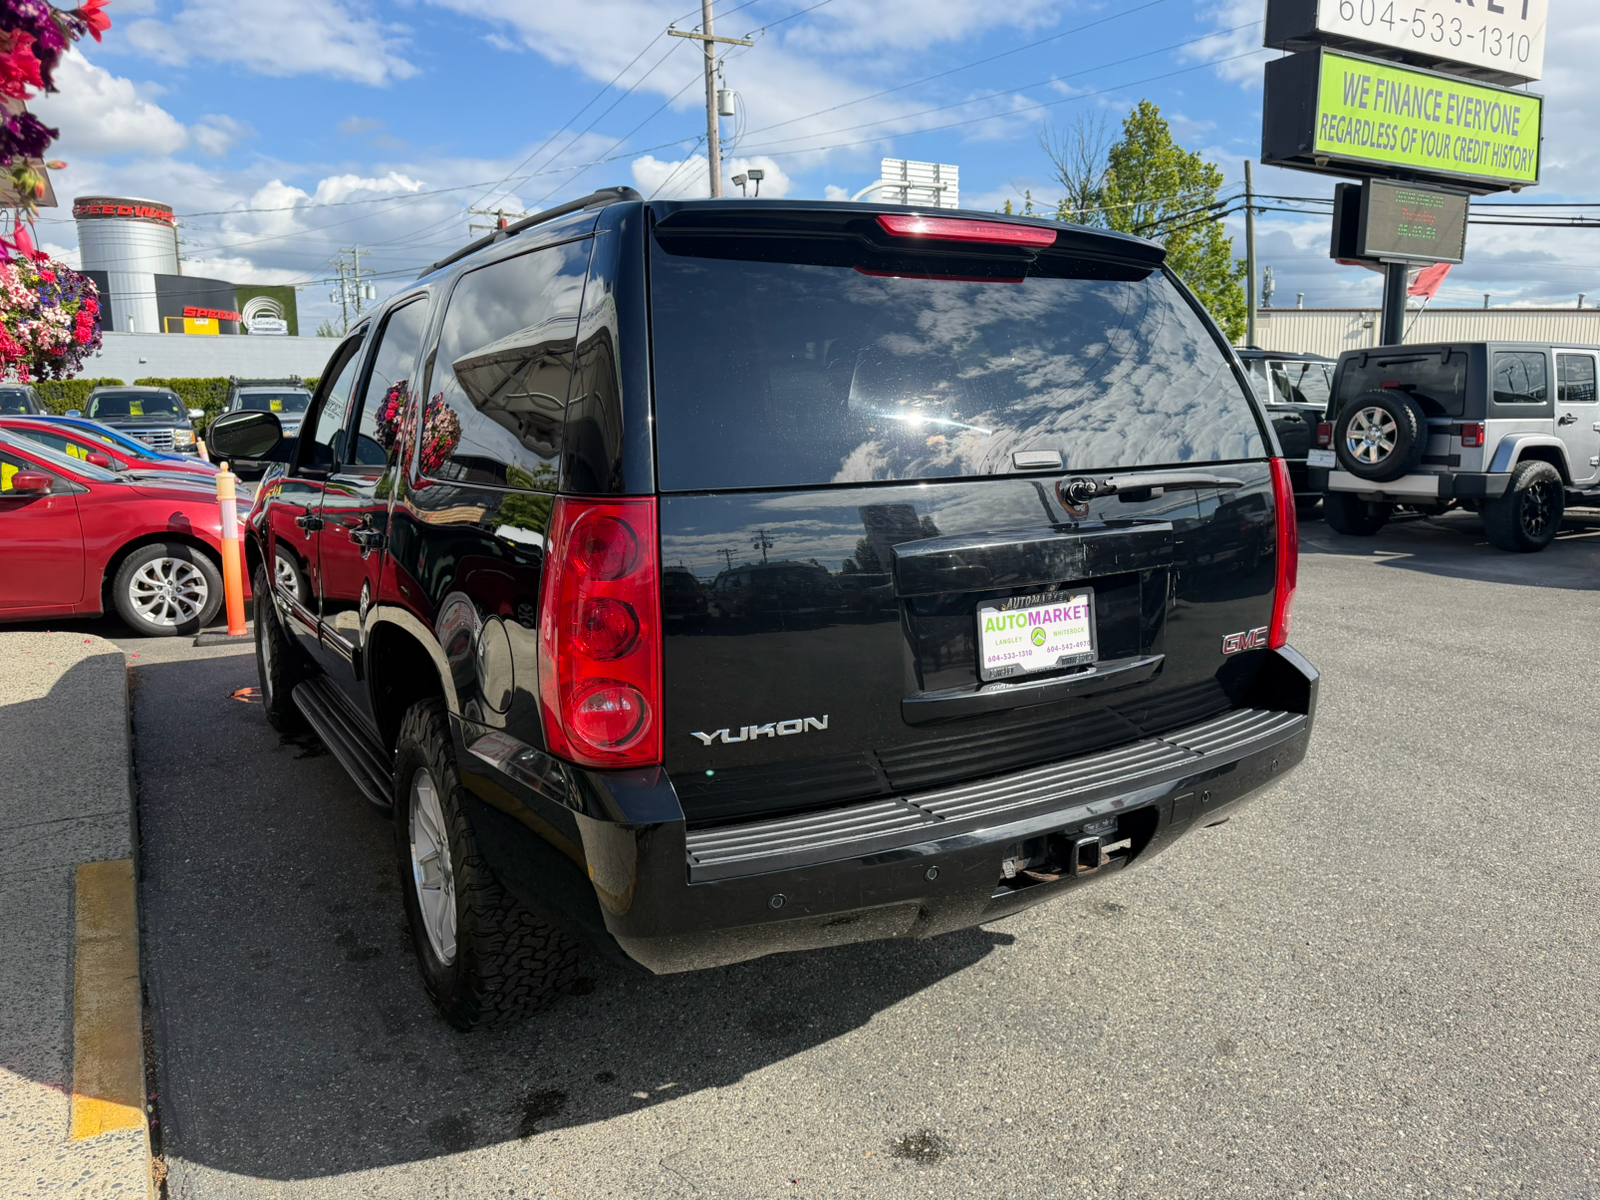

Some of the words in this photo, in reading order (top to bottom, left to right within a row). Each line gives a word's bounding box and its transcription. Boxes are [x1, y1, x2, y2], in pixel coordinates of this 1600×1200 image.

[1339, 0, 1530, 63] 604-533-1310
[1343, 71, 1371, 109] WE
[1373, 78, 1443, 123] FINANCE
[1445, 92, 1521, 137] EVERYONE
[1319, 112, 1398, 151] REGARDLESS
[1400, 126, 1418, 153] OF
[1420, 129, 1451, 159] YOUR
[1453, 135, 1491, 165] CREDIT
[1490, 142, 1535, 173] HISTORY
[985, 604, 1089, 633] AUTOMARKET
[988, 650, 1033, 662] 604-533-1310
[1047, 640, 1090, 653] 604-542-4970
[995, 637, 1022, 646] LANGLEY
[1053, 627, 1085, 636] WHITEROCK
[1222, 626, 1268, 655] GMC
[690, 714, 829, 746] YUKON
